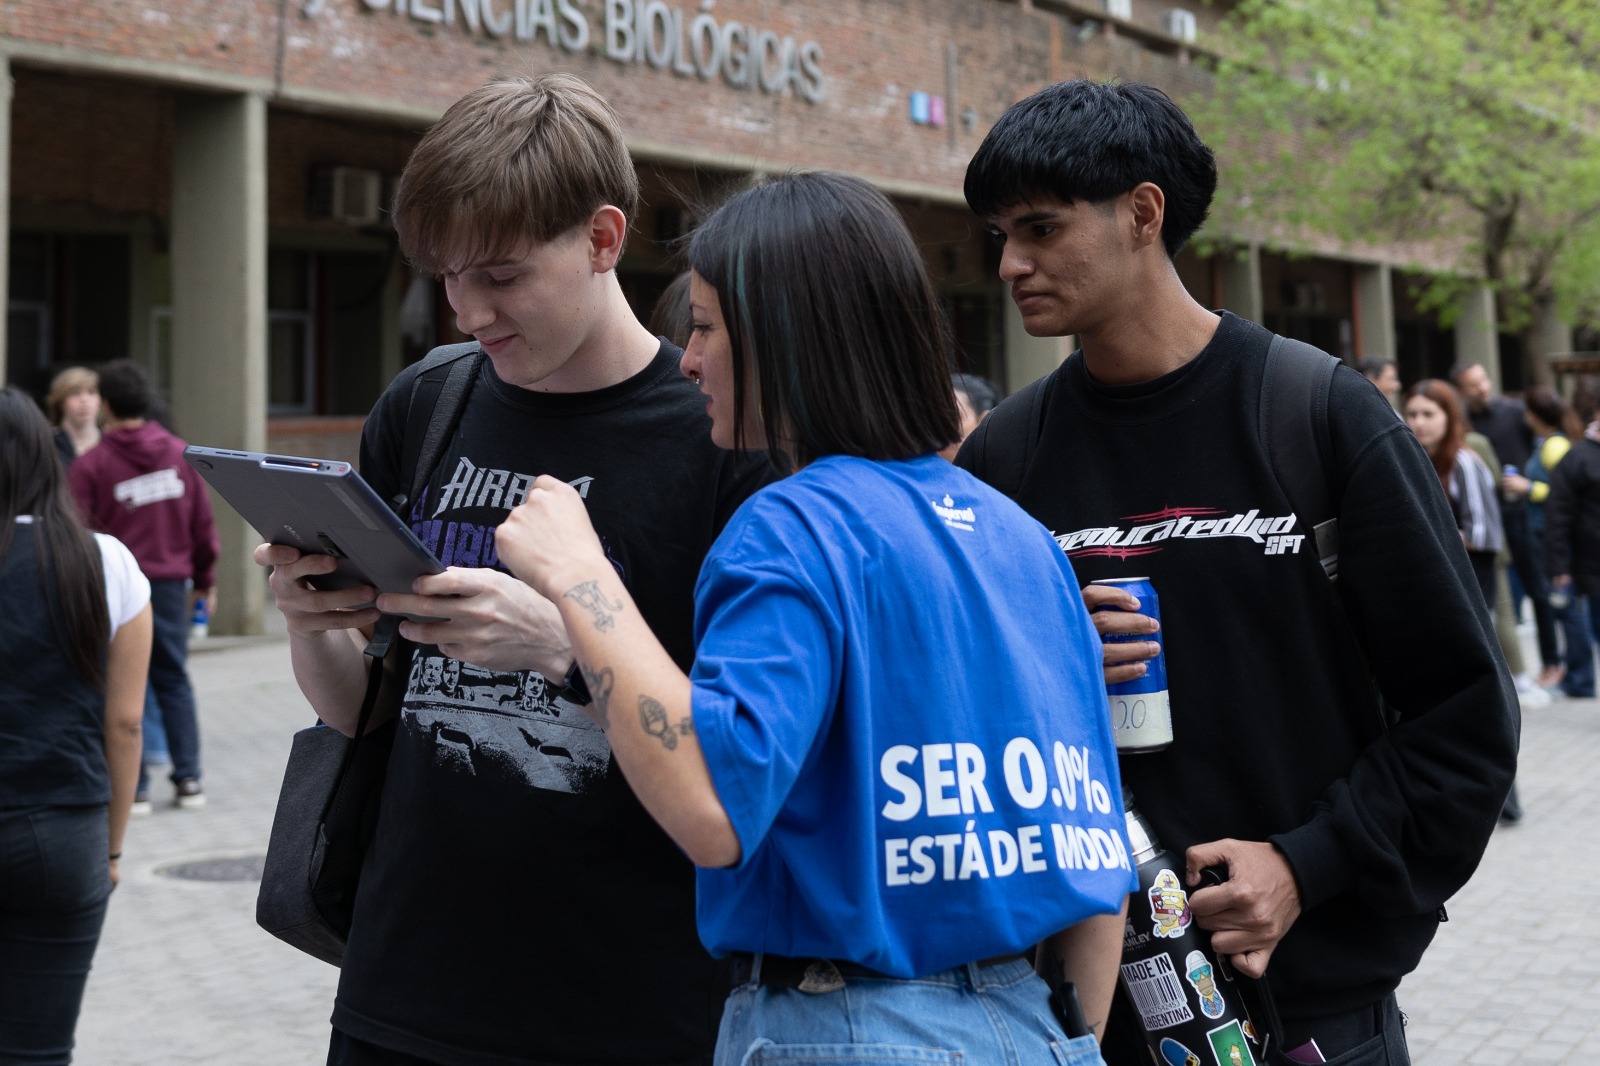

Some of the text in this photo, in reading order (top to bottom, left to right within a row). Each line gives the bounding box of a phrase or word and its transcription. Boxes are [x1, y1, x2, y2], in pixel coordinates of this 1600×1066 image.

[605, 0, 826, 102] BIOLÓGICAS
[432, 456, 595, 518] AIRB
[1264, 535, 1305, 555] SFT
[880, 737, 1111, 821] SER 0.0%
[885, 820, 1132, 886] ESTÁ DE MODA
[1124, 931, 1150, 947] ANLEY
[1121, 955, 1172, 983] MADE IN
[1144, 1006, 1191, 1029] ARGENTINA
